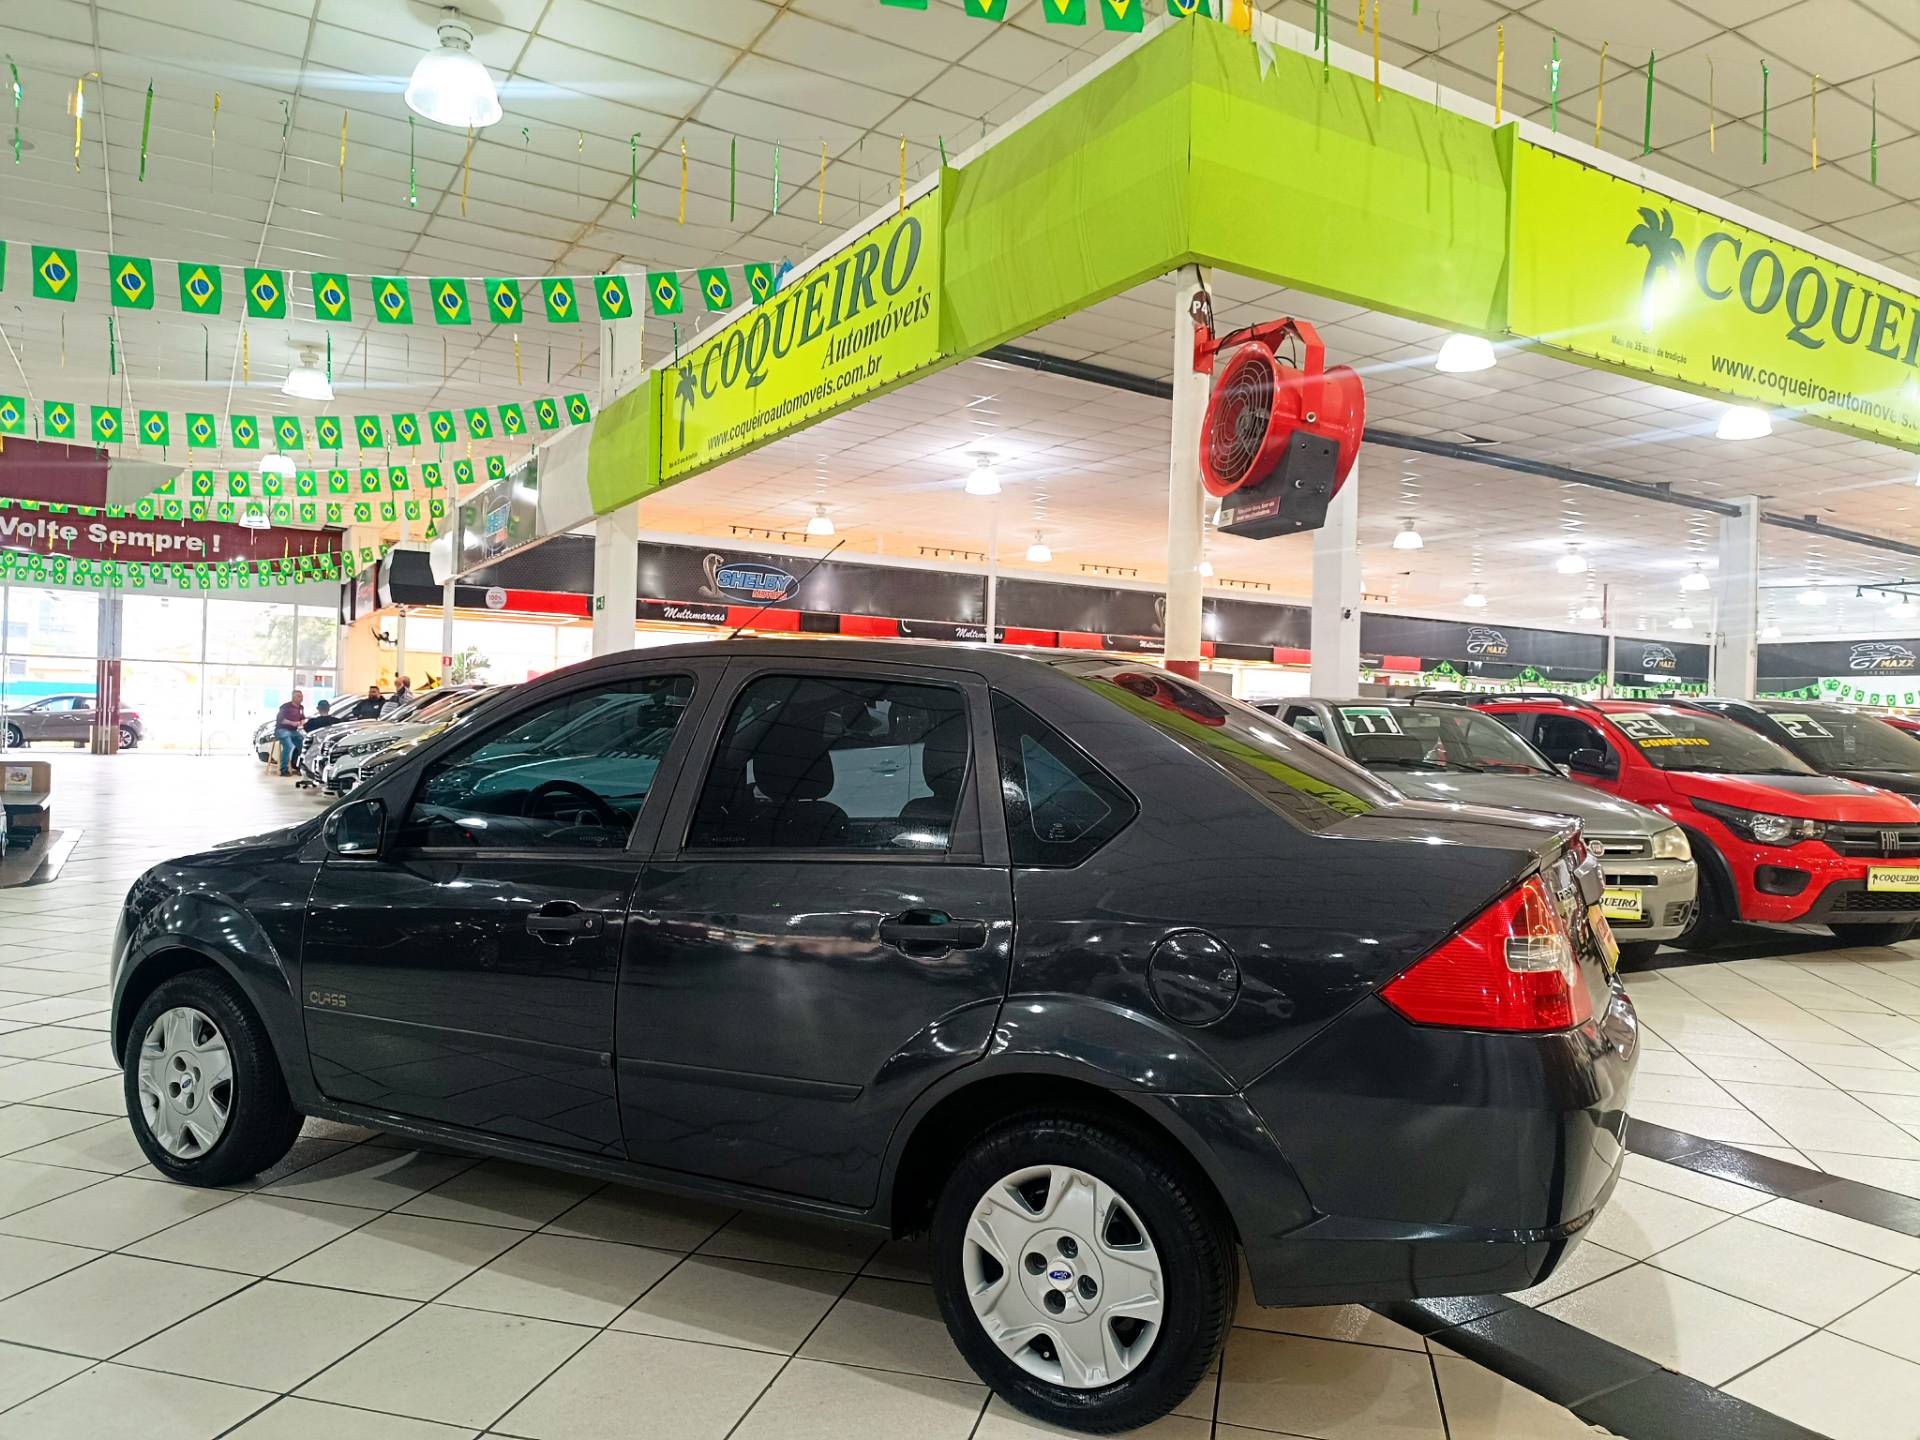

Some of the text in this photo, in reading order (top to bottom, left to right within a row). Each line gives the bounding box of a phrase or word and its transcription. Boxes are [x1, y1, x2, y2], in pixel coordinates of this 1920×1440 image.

[700, 217, 922, 399] COQUEIRO
[1193, 300, 1208, 314] P4
[821, 285, 931, 369] Automóveis
[708, 355, 883, 450] www.coqueiroautomoveis.com.br
[0, 516, 78, 541] Volte
[88, 523, 203, 552] Sempre
[717, 570, 793, 591] SHELBY
[663, 606, 726, 621] Multimarcas
[1466, 642, 1491, 653] GT
[1642, 657, 1663, 668] GT
[1849, 657, 1915, 669] GT MAXX
[1358, 714, 1399, 733] 11
[1619, 719, 1669, 737] 24
[1637, 737, 1710, 748] COMPLETO
[1881, 831, 1899, 850] FIAT
[1878, 873, 1920, 883] COQUEIRO
[309, 990, 347, 1008] CLASS
